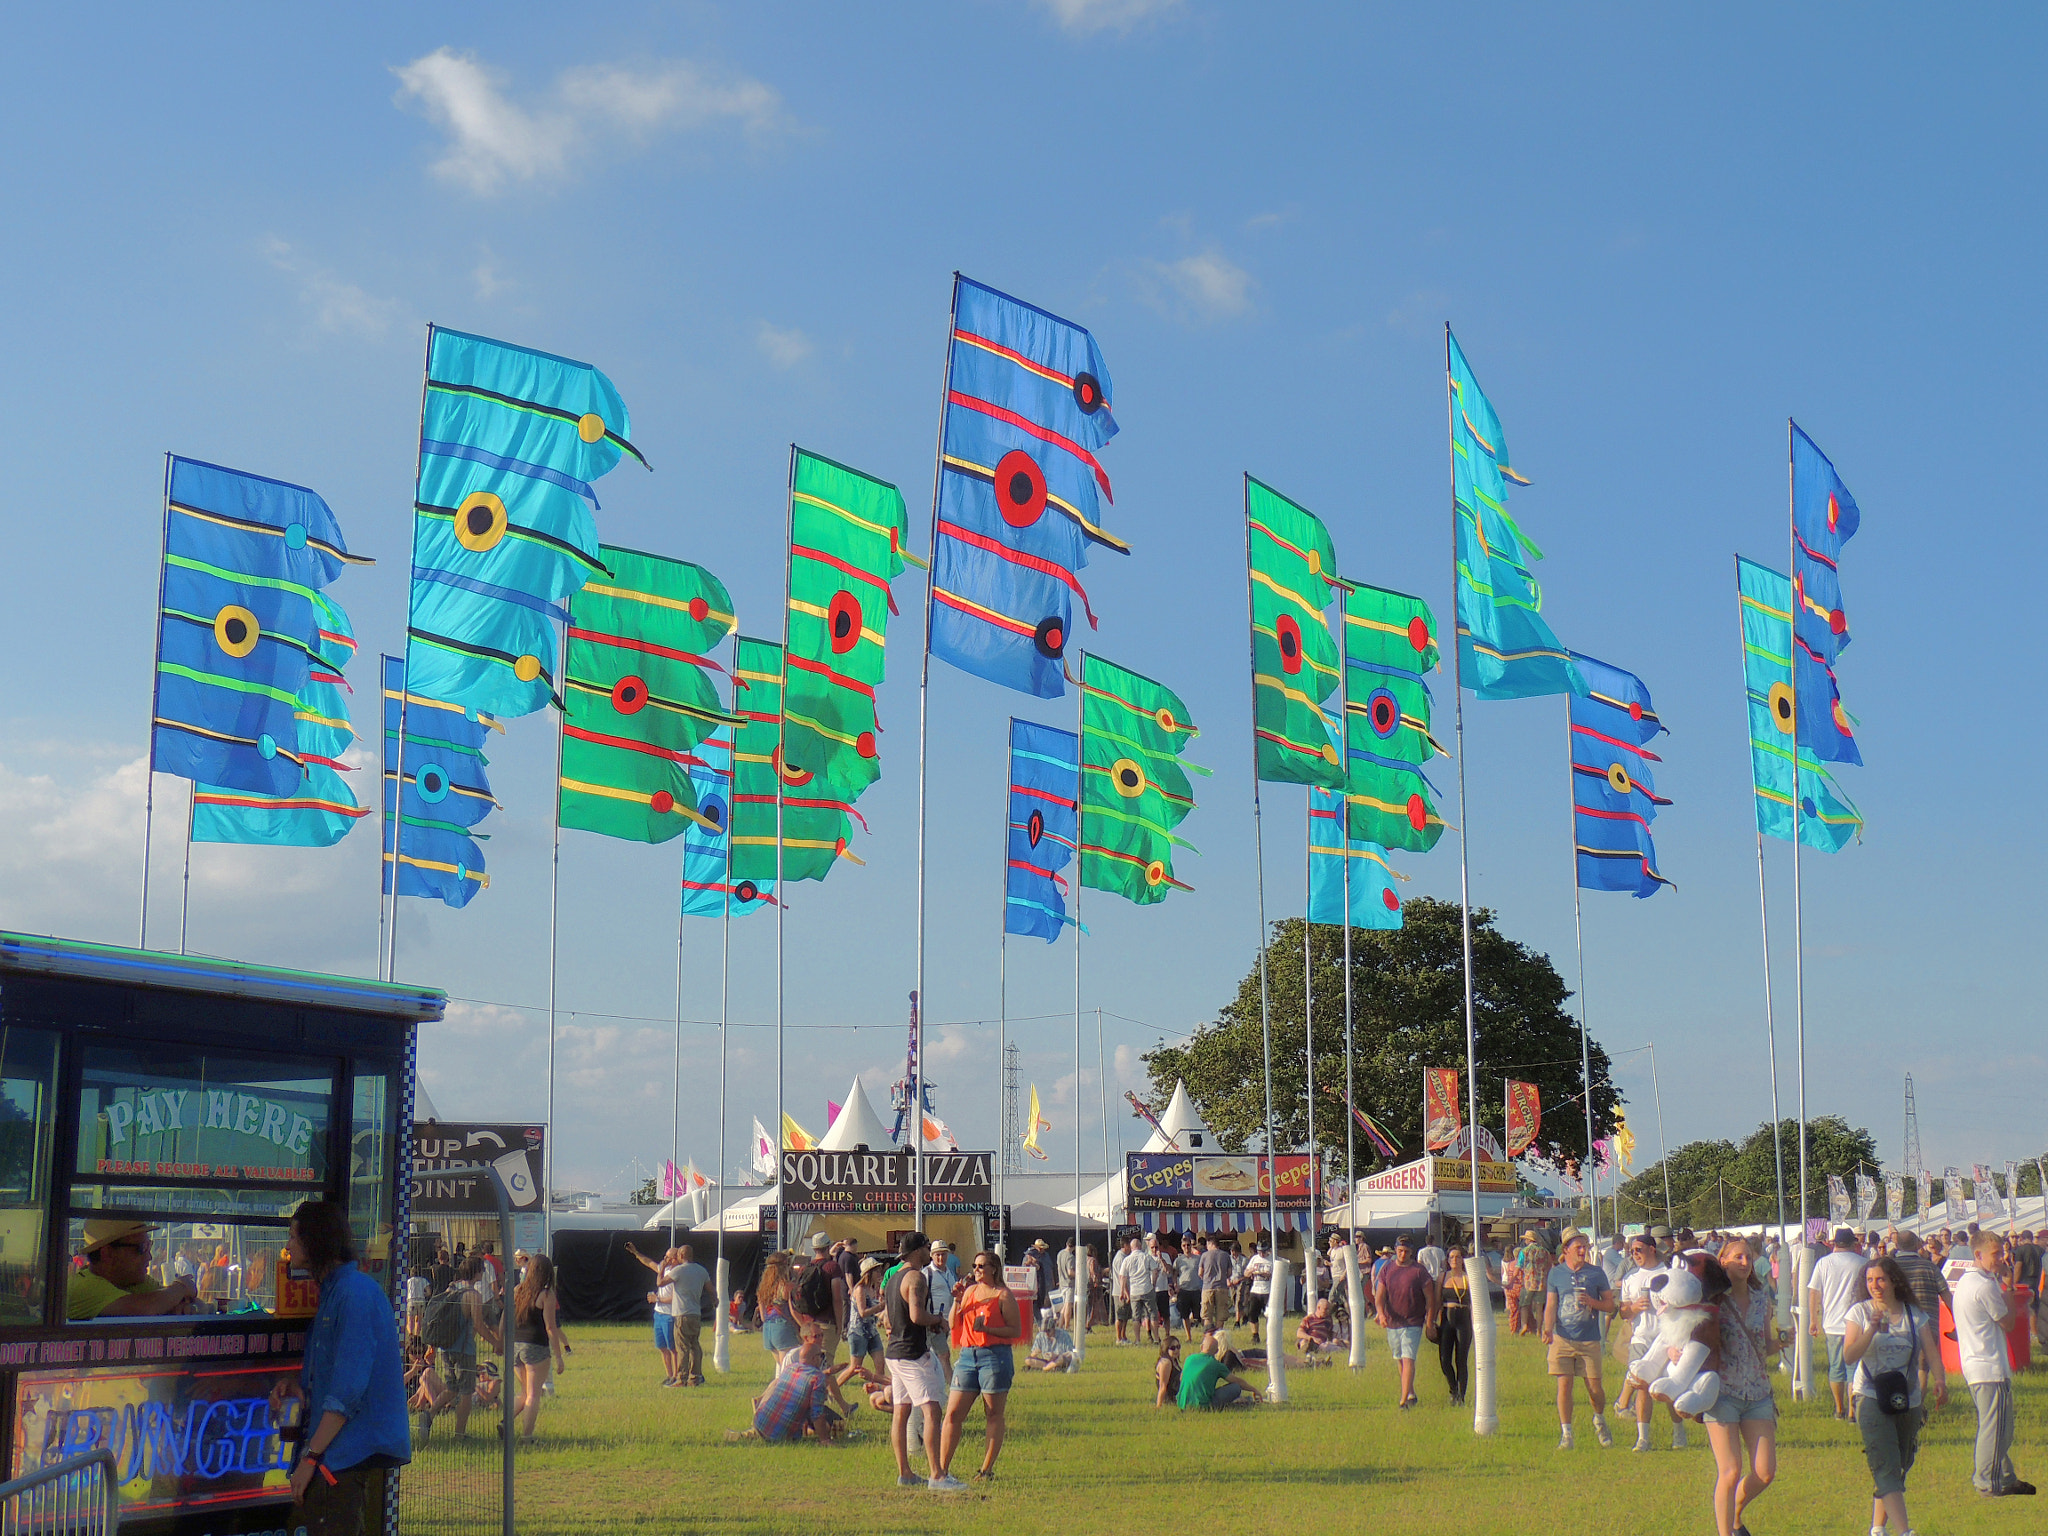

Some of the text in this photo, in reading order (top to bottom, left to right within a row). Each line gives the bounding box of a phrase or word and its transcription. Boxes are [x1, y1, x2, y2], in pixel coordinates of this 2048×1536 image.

[106, 1089, 314, 1155] PAY HERE
[1512, 1083, 1535, 1134] BURGERS
[97, 1159, 314, 1181] PLEASE SECURE ALL VALUABLES
[783, 1153, 897, 1190] SQUARE
[1130, 1159, 1193, 1192] Crepes
[1367, 1164, 1426, 1190] BURGERS
[811, 1191, 964, 1203] CHIPS CHEESY CHIPS
[949, 1202, 992, 1212] DRINK
[1133, 1197, 1157, 1207] Fruit
[1156, 1198, 1180, 1209] Juice
[1186, 1200, 1204, 1209] Hot
[1205, 1200, 1213, 1209] &
[1215, 1199, 1236, 1209] Cold
[1238, 1199, 1268, 1209] Drinks
[1, 1342, 38, 1364] DON'T
[41, 1340, 86, 1362] FORGET
[89, 1340, 104, 1360] TO
[108, 1339, 131, 1359] BUY
[134, 1337, 164, 1358] YOUR
[167, 1334, 245, 1357] PERSONALISED
[248, 1333, 268, 1353] DVD
[271, 1332, 284, 1352] OF
